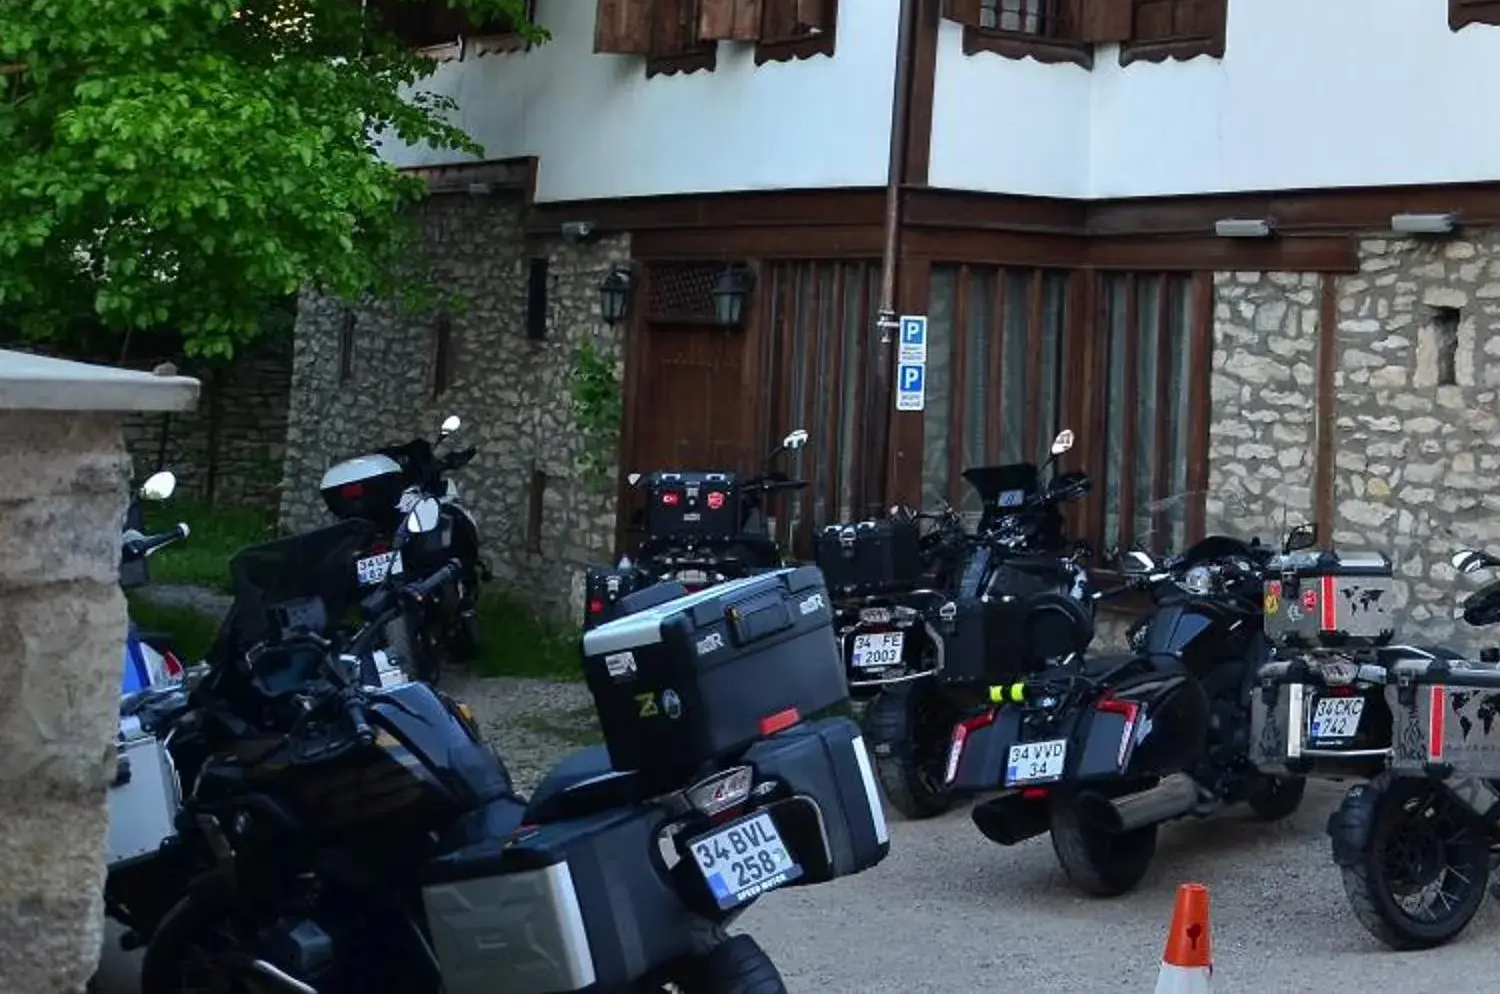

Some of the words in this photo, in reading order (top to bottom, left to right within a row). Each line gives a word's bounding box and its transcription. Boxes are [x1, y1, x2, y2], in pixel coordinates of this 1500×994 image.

[906, 321, 920, 341] P
[904, 367, 919, 389] P
[865, 649, 897, 663] 2003
[1011, 746, 1029, 763] 34
[1029, 760, 1048, 777] 34
[696, 838, 731, 869] 34
[726, 819, 777, 855] BVL
[730, 848, 777, 888] 258
